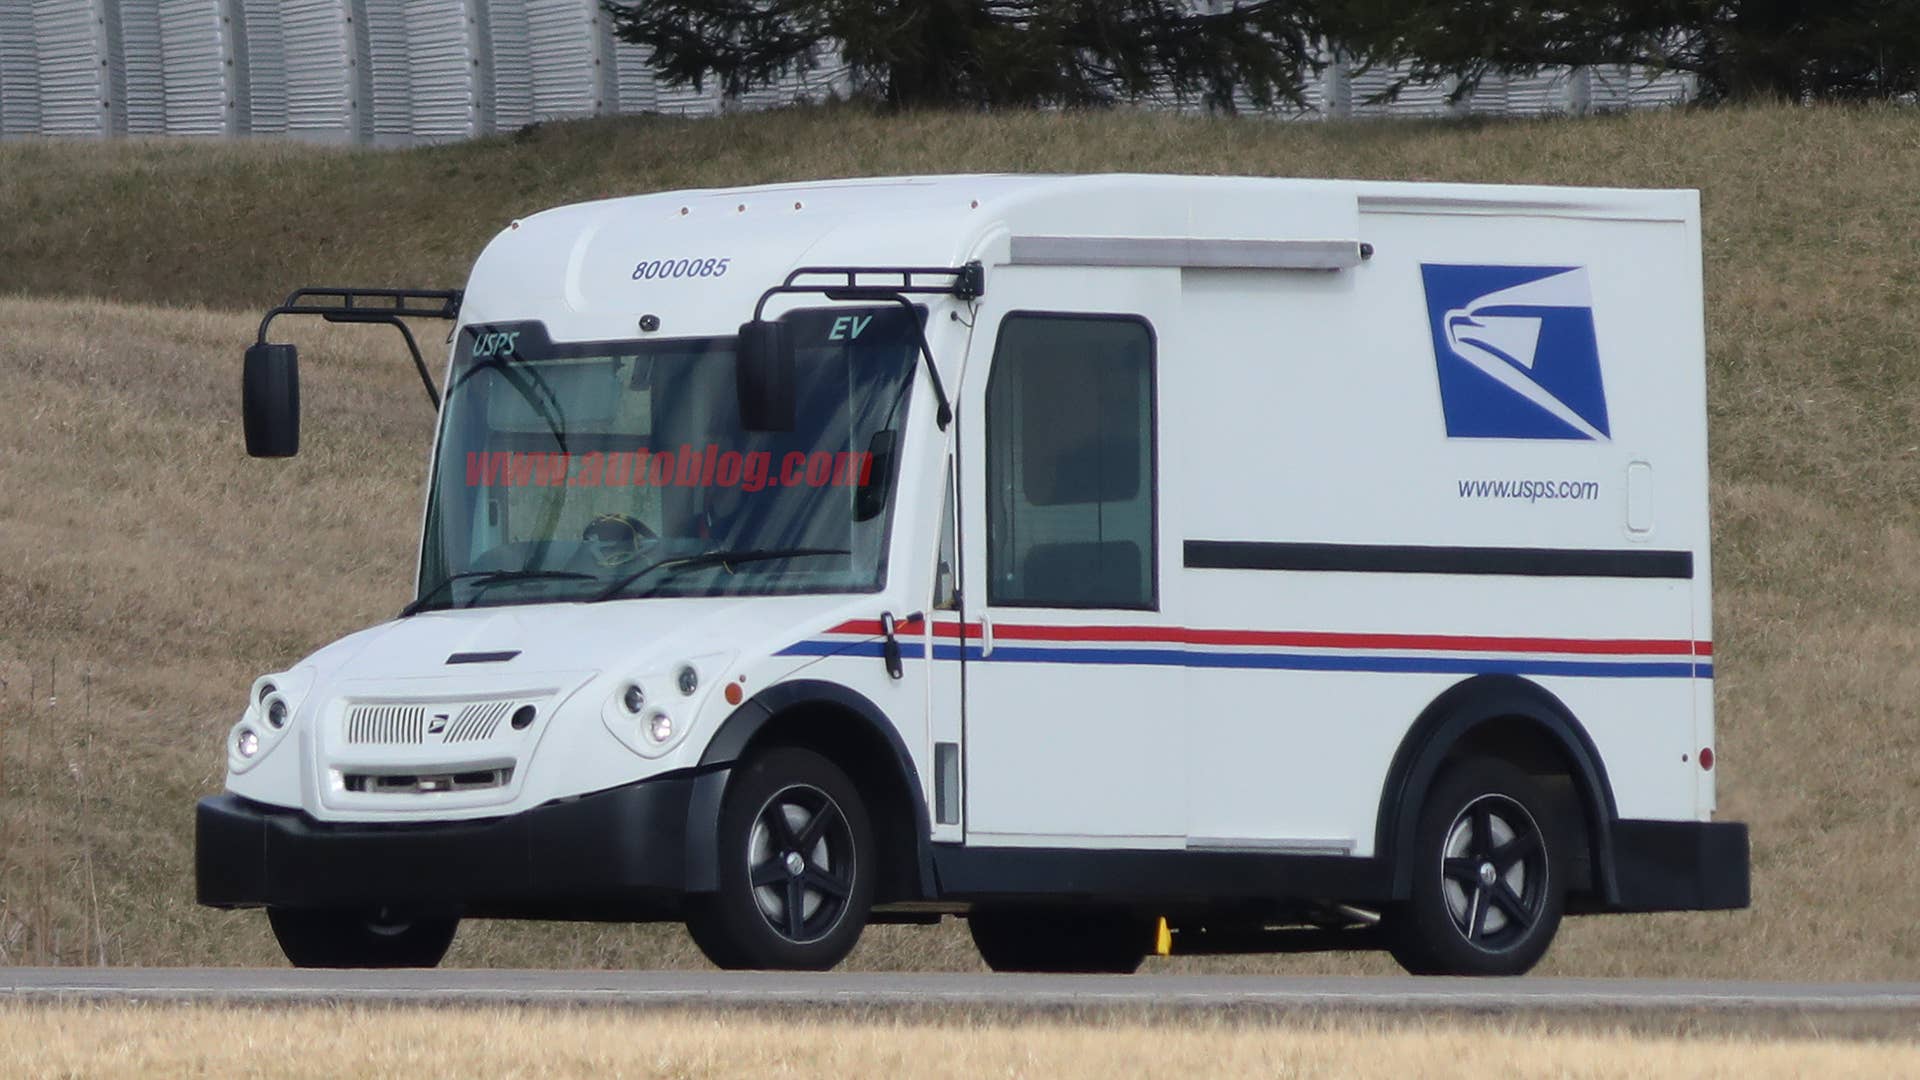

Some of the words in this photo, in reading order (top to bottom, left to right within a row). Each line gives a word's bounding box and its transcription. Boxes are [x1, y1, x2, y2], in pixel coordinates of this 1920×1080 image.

[632, 257, 731, 280] 8000085
[828, 315, 873, 341] EV
[472, 331, 520, 358] USPS
[1458, 479, 1599, 504] www.usps.com
